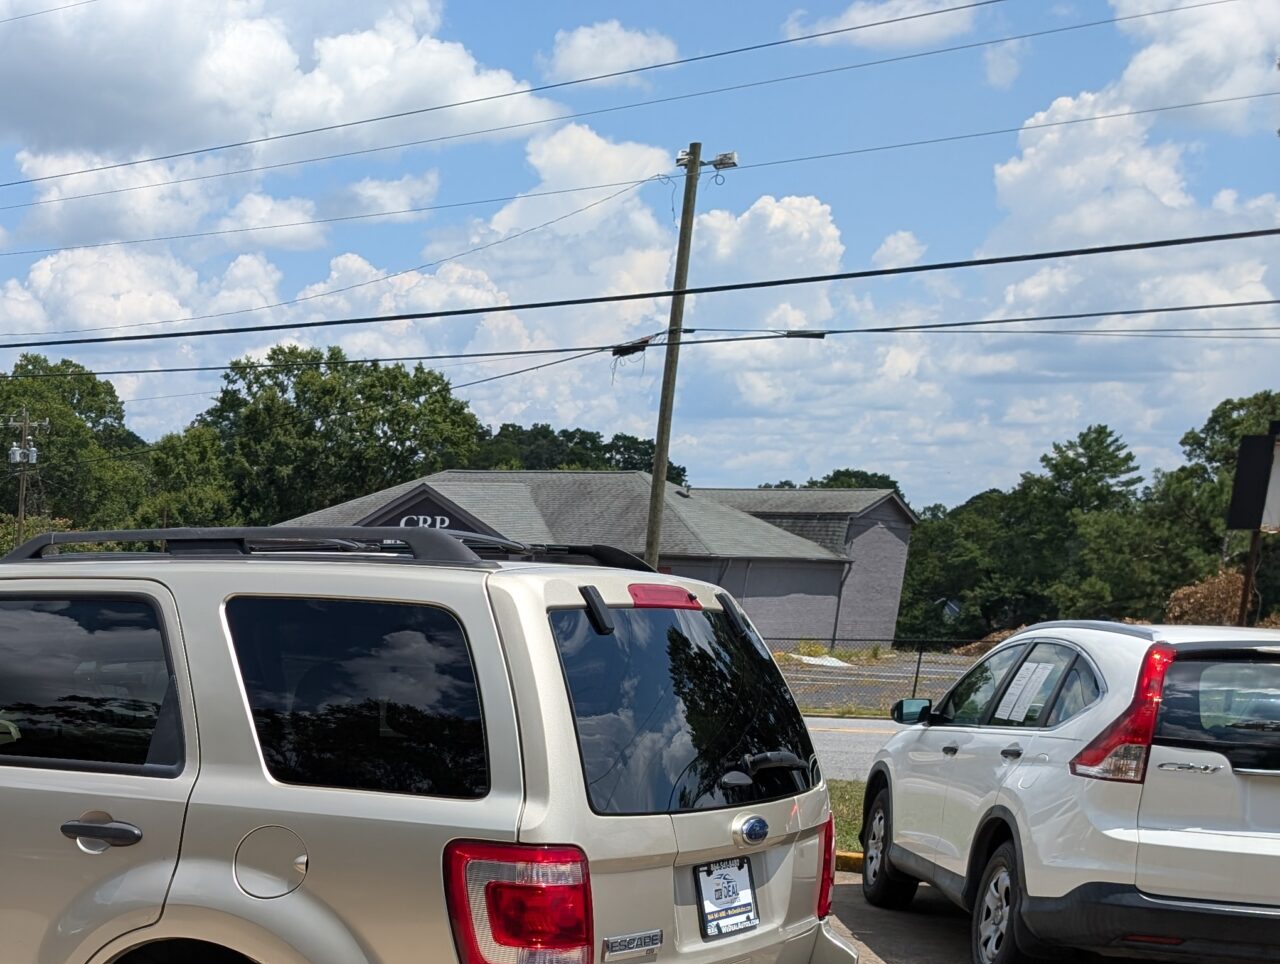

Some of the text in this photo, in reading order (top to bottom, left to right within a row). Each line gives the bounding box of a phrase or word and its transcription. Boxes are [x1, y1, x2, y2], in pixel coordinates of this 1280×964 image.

[399, 515, 450, 528] CRP
[723, 884, 740, 899] DEAL
[610, 934, 658, 952] ESCAPE
